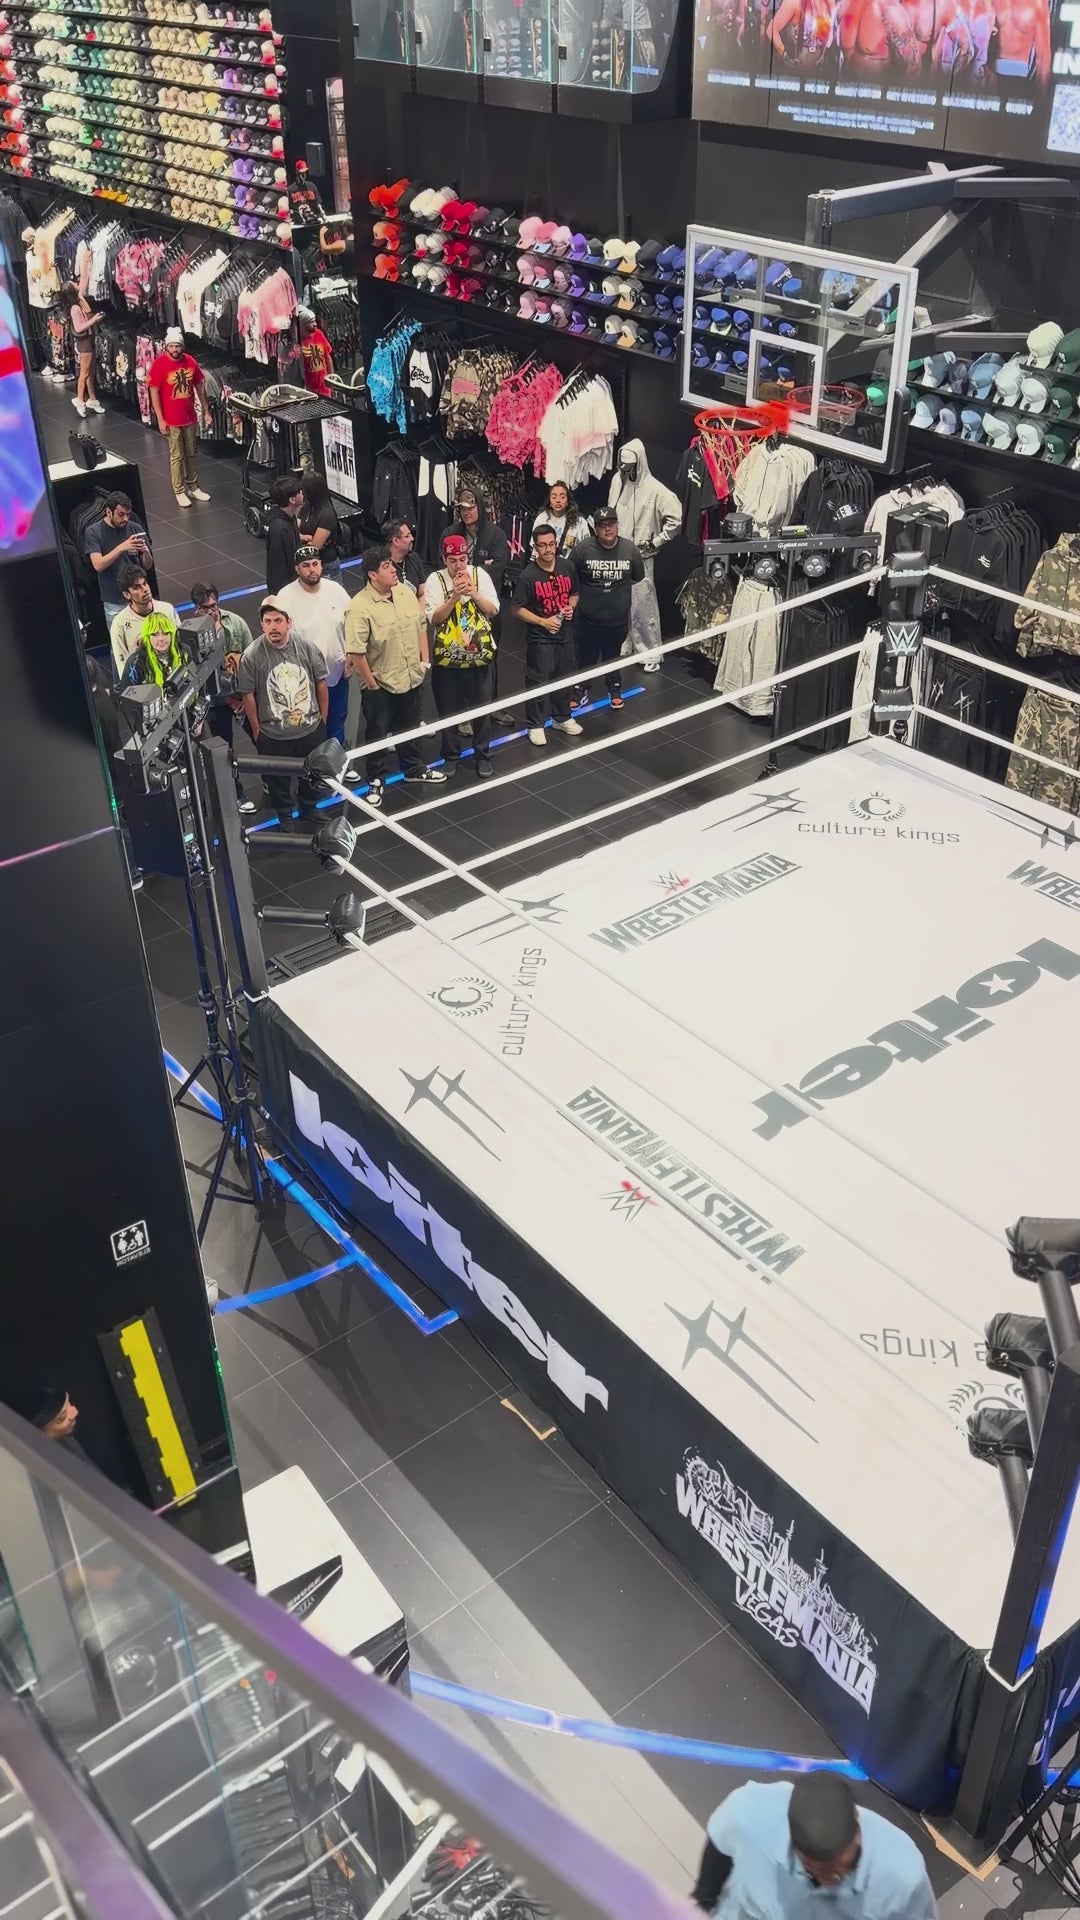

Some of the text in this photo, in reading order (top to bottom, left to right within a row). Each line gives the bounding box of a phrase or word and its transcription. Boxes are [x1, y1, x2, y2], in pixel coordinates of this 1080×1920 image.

[586, 560, 630, 570] WRESTLING
[592, 571, 623, 579] IS REAL
[797, 821, 960, 845] culture kings
[587, 853, 802, 953] WRESTLEMANIA
[512, 947, 547, 987] kings
[565, 1087, 807, 1275] WRESTLEMANIA
[859, 1328, 959, 1368] kings
[676, 1472, 877, 1704] WRESTLEMANIA
[734, 1575, 800, 1648] VEGAS
